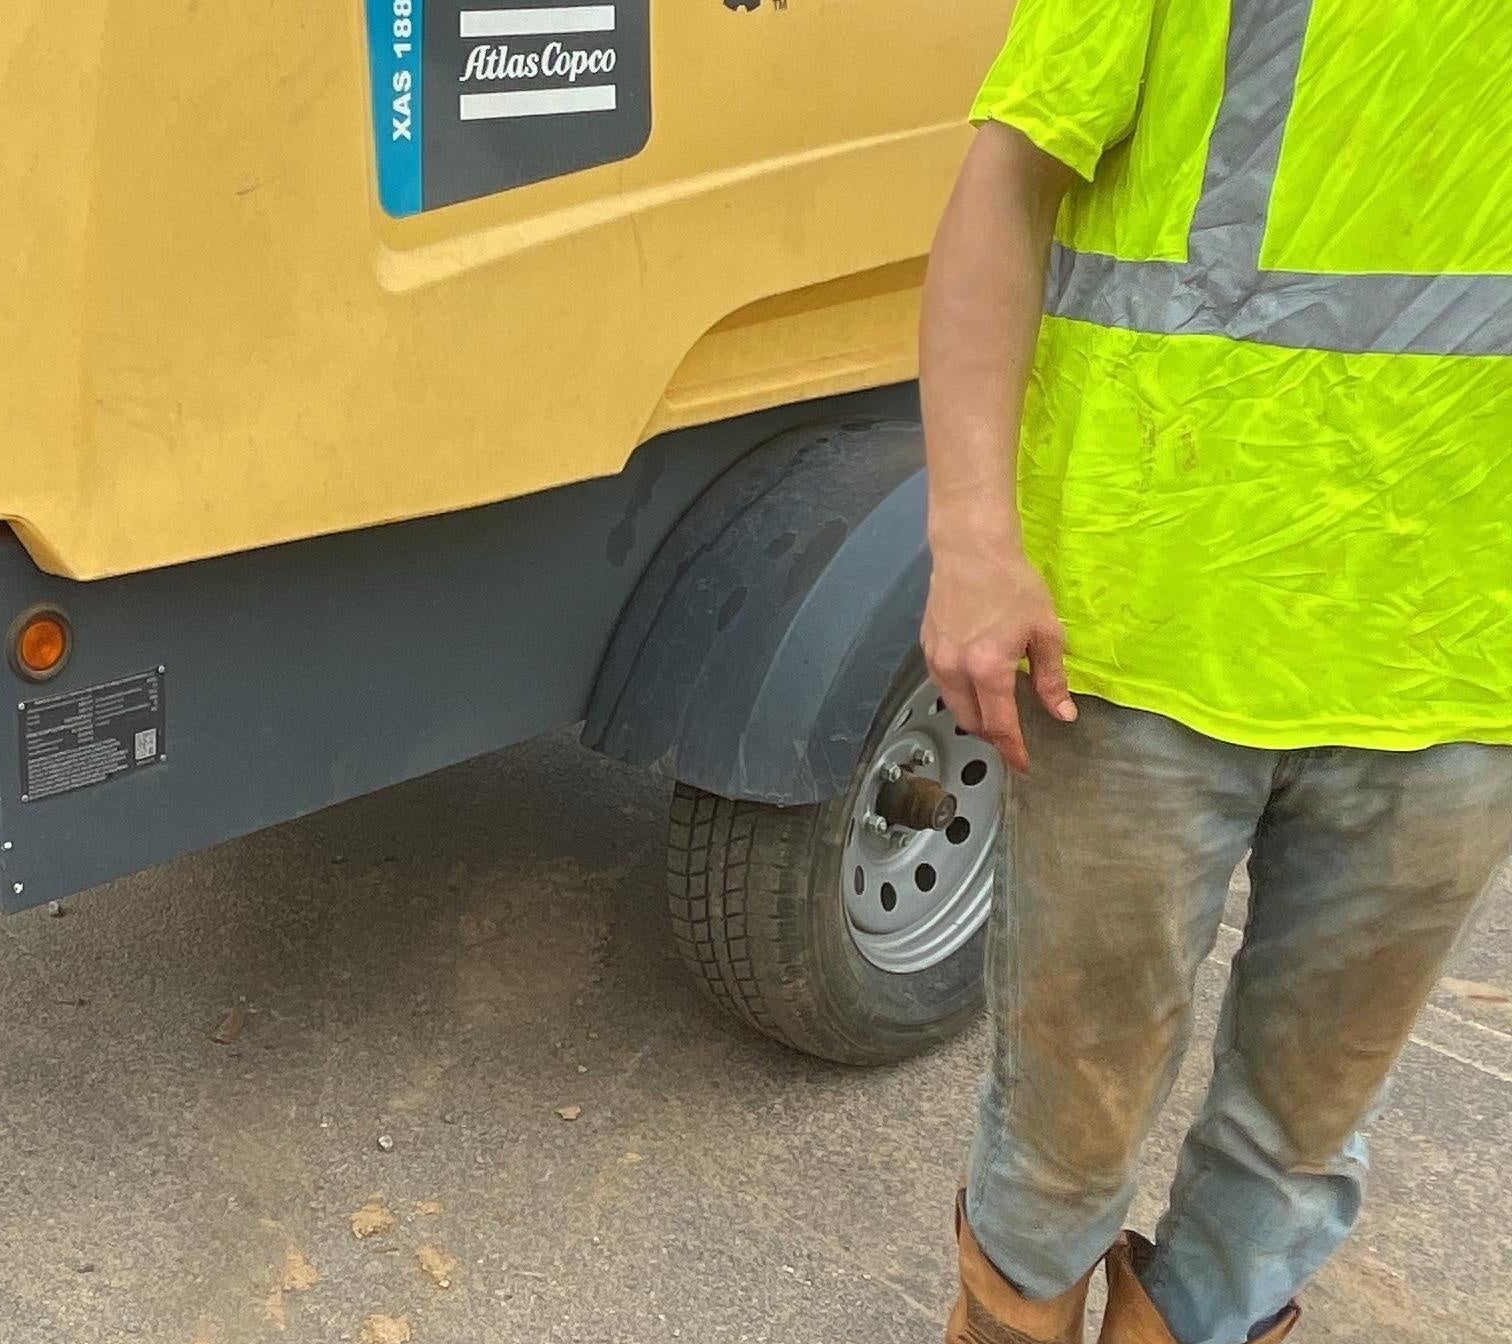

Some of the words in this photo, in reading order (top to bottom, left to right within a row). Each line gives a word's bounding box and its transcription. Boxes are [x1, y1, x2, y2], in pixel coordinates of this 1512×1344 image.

[459, 44, 539, 82] Atlas
[541, 41, 617, 83] Copco
[392, 69, 413, 141] XAS
